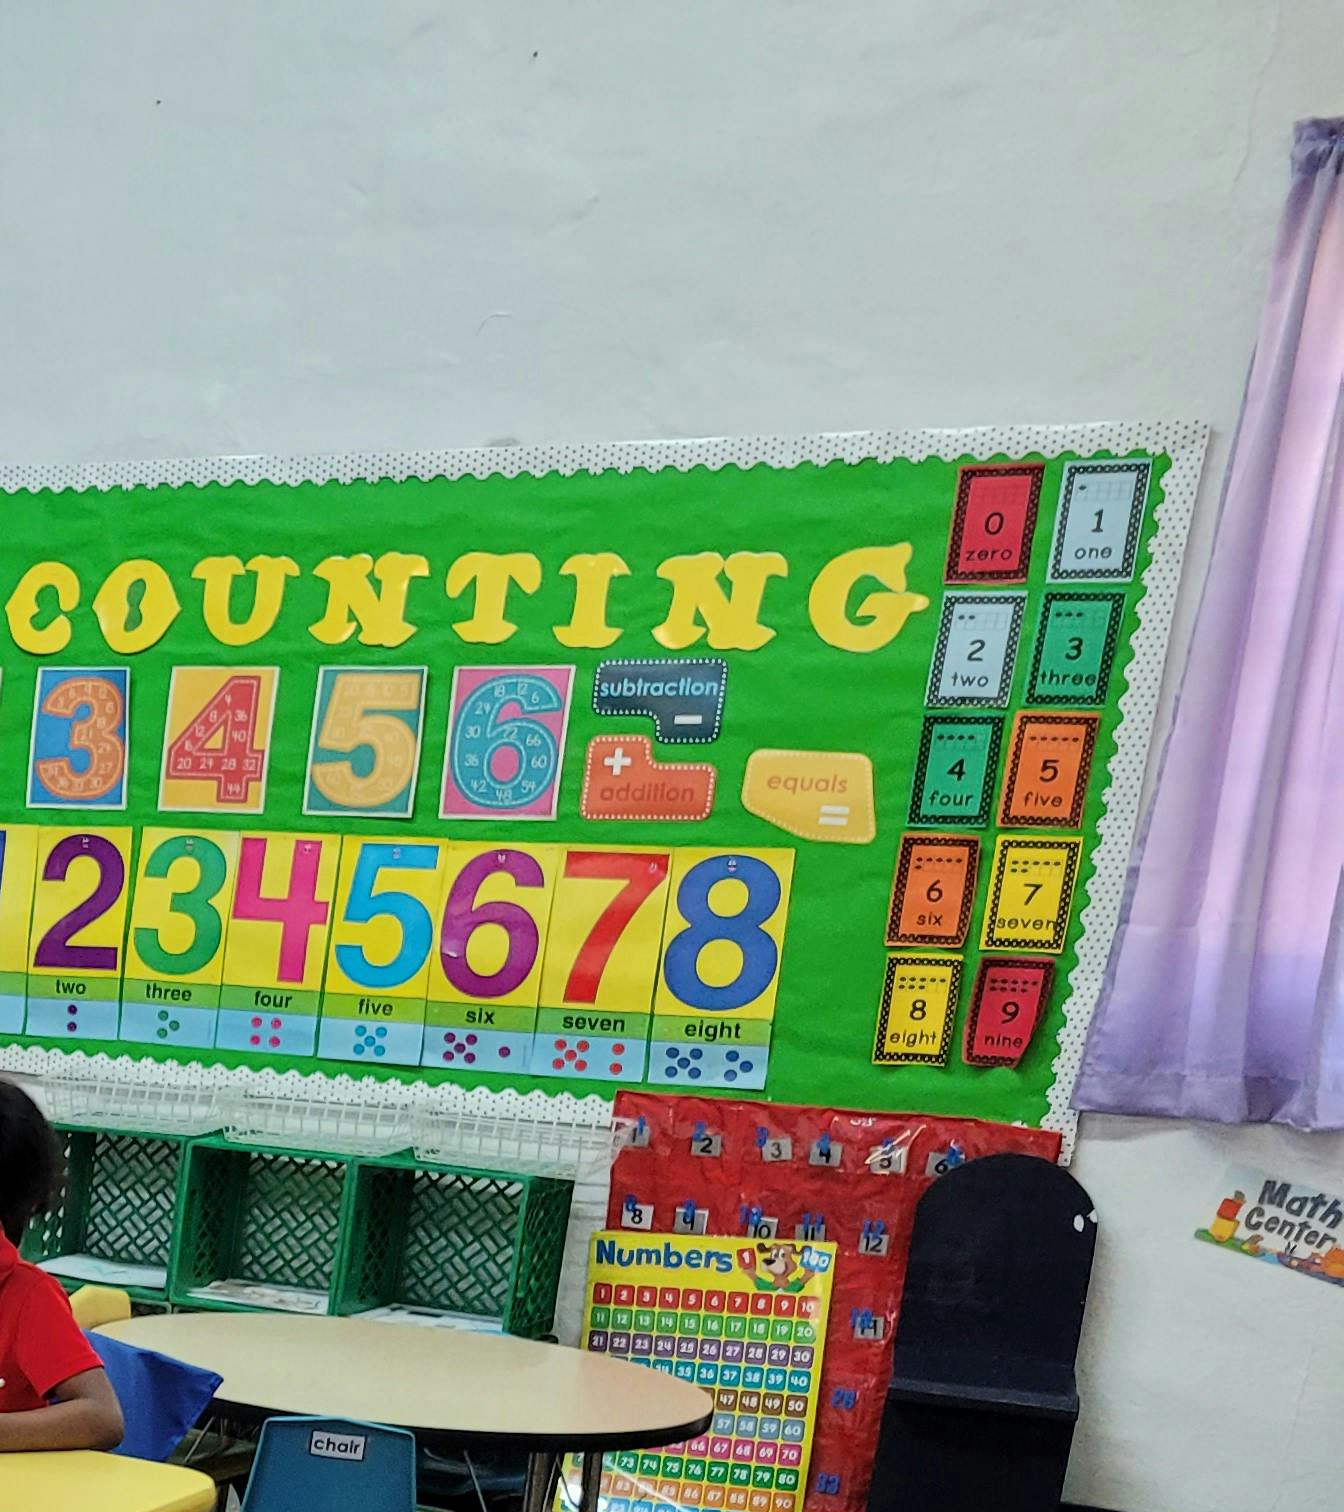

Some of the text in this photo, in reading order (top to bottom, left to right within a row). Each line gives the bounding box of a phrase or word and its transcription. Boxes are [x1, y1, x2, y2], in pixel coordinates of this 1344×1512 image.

[984, 512, 1004, 535] 0
[1091, 509, 1104, 533] 1
[965, 549, 1013, 562] zero
[1074, 546, 1113, 560] one
[4, 543, 930, 655] COUNTING
[967, 639, 986, 662] 2
[1065, 637, 1084, 661] 3
[599, 677, 719, 697] subtraction
[951, 671, 989, 688] two
[1040, 669, 1097, 687] three
[35, 676, 125, 800] 3
[166, 676, 265, 803] 4
[311, 673, 421, 808] 5
[451, 673, 563, 810] 6
[946, 758, 966, 781] 4
[1039, 759, 1059, 782] 5
[599, 781, 695, 802] addition
[766, 773, 849, 794] equals
[928, 790, 974, 807] four
[1023, 791, 1063, 808] five
[926, 879, 943, 902] 6
[1023, 883, 1043, 906] 7
[33, 834, 125, 970] 2
[134, 834, 227, 975] 3
[232, 837, 329, 984] 4
[335, 843, 439, 988] 5
[441, 849, 544, 998] 6
[563, 851, 670, 1004] 7
[663, 854, 781, 1011] 8
[916, 912, 943, 927] six
[997, 917, 1057, 931] seven
[55, 978, 87, 995] two
[146, 983, 192, 1002] three
[254, 990, 292, 1009] four
[358, 998, 393, 1016] five
[465, 1007, 495, 1025] six
[562, 1014, 625, 1032] seven
[684, 1021, 741, 1042] eight
[909, 999, 927, 1021] 8
[1001, 1001, 1020, 1024] 9
[889, 1030, 937, 1048] eight
[984, 1032, 1023, 1049] nine
[700, 1137, 713, 1154] 2
[771, 1142, 782, 1158] 3
[935, 1159, 948, 1174] 6
[1258, 1180, 1343, 1229] Math
[630, 1208, 643, 1225] 8
[864, 1238, 882, 1252] 12
[1245, 1207, 1337, 1249] Center
[595, 1240, 733, 1273] Numbers
[599, 1288, 815, 1313] 1 2 3 4 5 6 7 8 9 10
[596, 1311, 813, 1338] 11 12 13 14 15 16 17 18 19 20
[592, 1335, 810, 1363] 21 22 23 24 25 26 27 28 29 30
[677, 1365, 808, 1387] 35 36 37 38 39 40
[720, 1393, 804, 1412] 47 48 49 50
[313, 1437, 361, 1455] chair
[713, 1441, 797, 1461] 67 68 69 70
